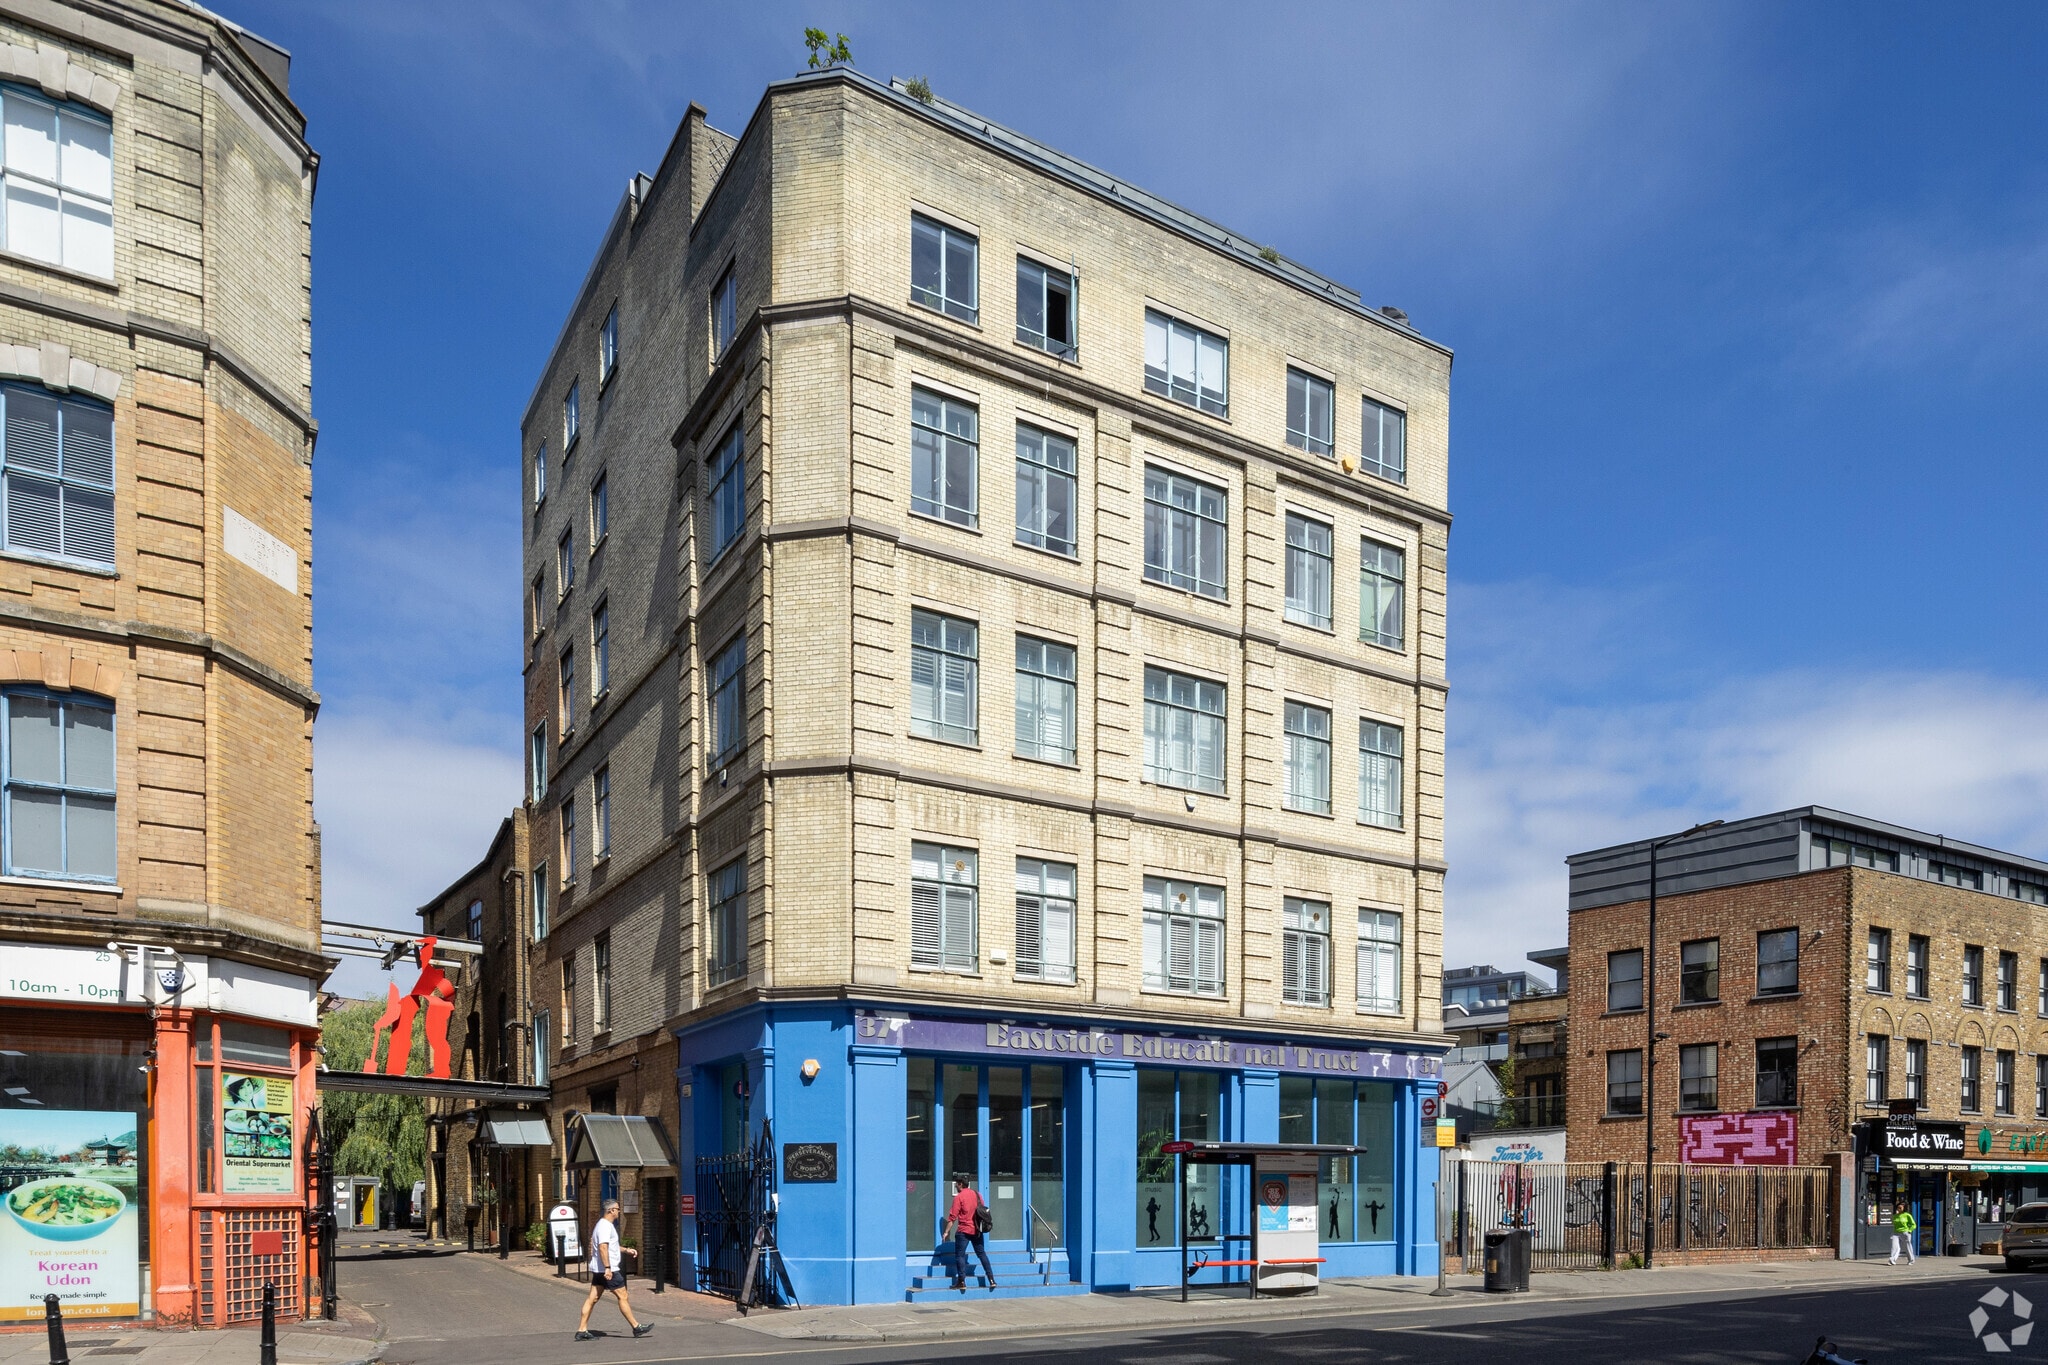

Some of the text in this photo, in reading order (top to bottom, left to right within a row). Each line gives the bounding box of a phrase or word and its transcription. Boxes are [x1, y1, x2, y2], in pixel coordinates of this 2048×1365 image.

[96, 951, 111, 962] 25
[10, 979, 57, 994] 10am
[79, 983, 124, 999] 10pm
[858, 1017, 891, 1039] 37
[986, 1022, 1114, 1055] Eastside
[1292, 1045, 1360, 1072] Trust
[1418, 1057, 1440, 1075] 37
[1438, 1083, 1445, 1094] R
[1889, 1113, 1916, 1122] OPEN
[1886, 1132, 1964, 1150] Food & Wine
[788, 1148, 832, 1161] PERSEVERANCE
[1491, 1146, 1544, 1163] Time for
[226, 1158, 291, 1169] Oriental Supermarket
[800, 1164, 821, 1172] WORKS
[55, 1249, 89, 1257] yourself
[38, 1260, 98, 1272] Korean
[46, 1273, 91, 1286] Udon
[60, 1291, 82, 1299] made
[83, 1291, 107, 1300] simple
[26, 1305, 111, 1317] lonan.co.uk
